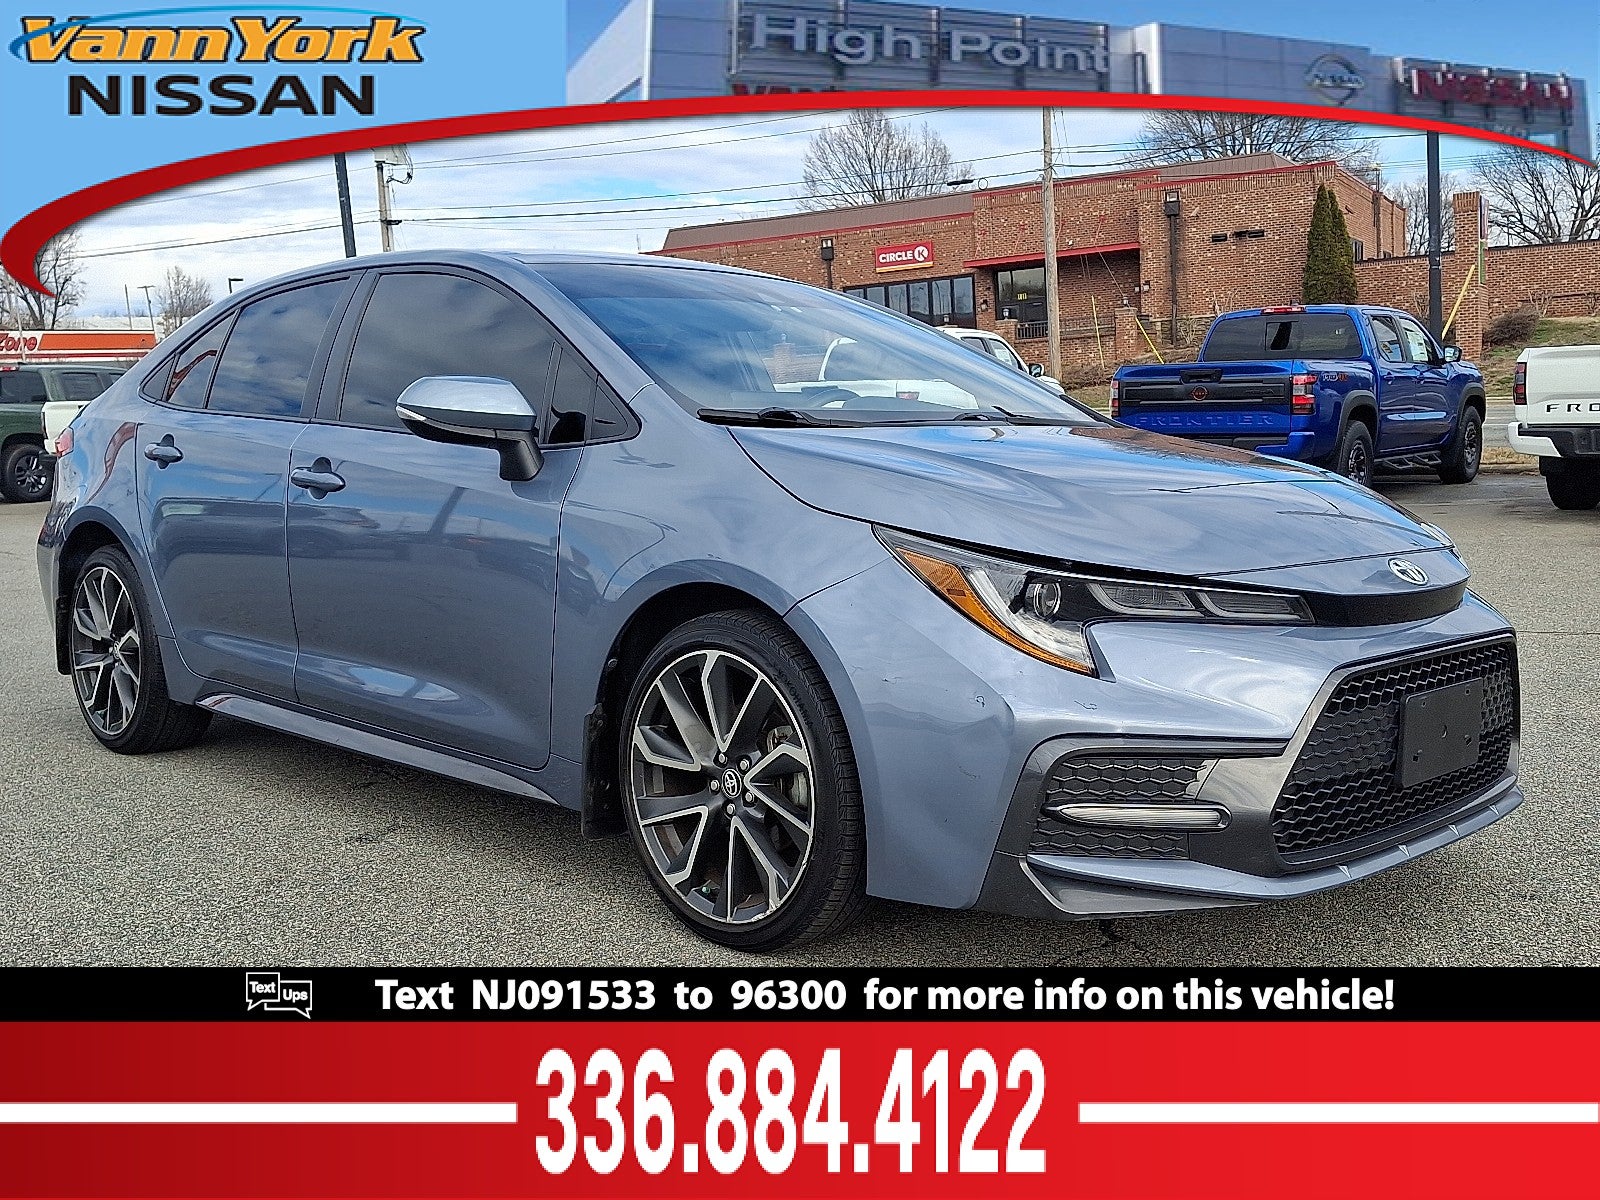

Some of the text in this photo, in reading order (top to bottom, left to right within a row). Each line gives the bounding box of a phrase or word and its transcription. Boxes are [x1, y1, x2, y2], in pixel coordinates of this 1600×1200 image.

[751, 14, 1110, 73] High Point
[878, 249, 914, 263] CIRCLE
[1134, 415, 1274, 426] FRONTIER
